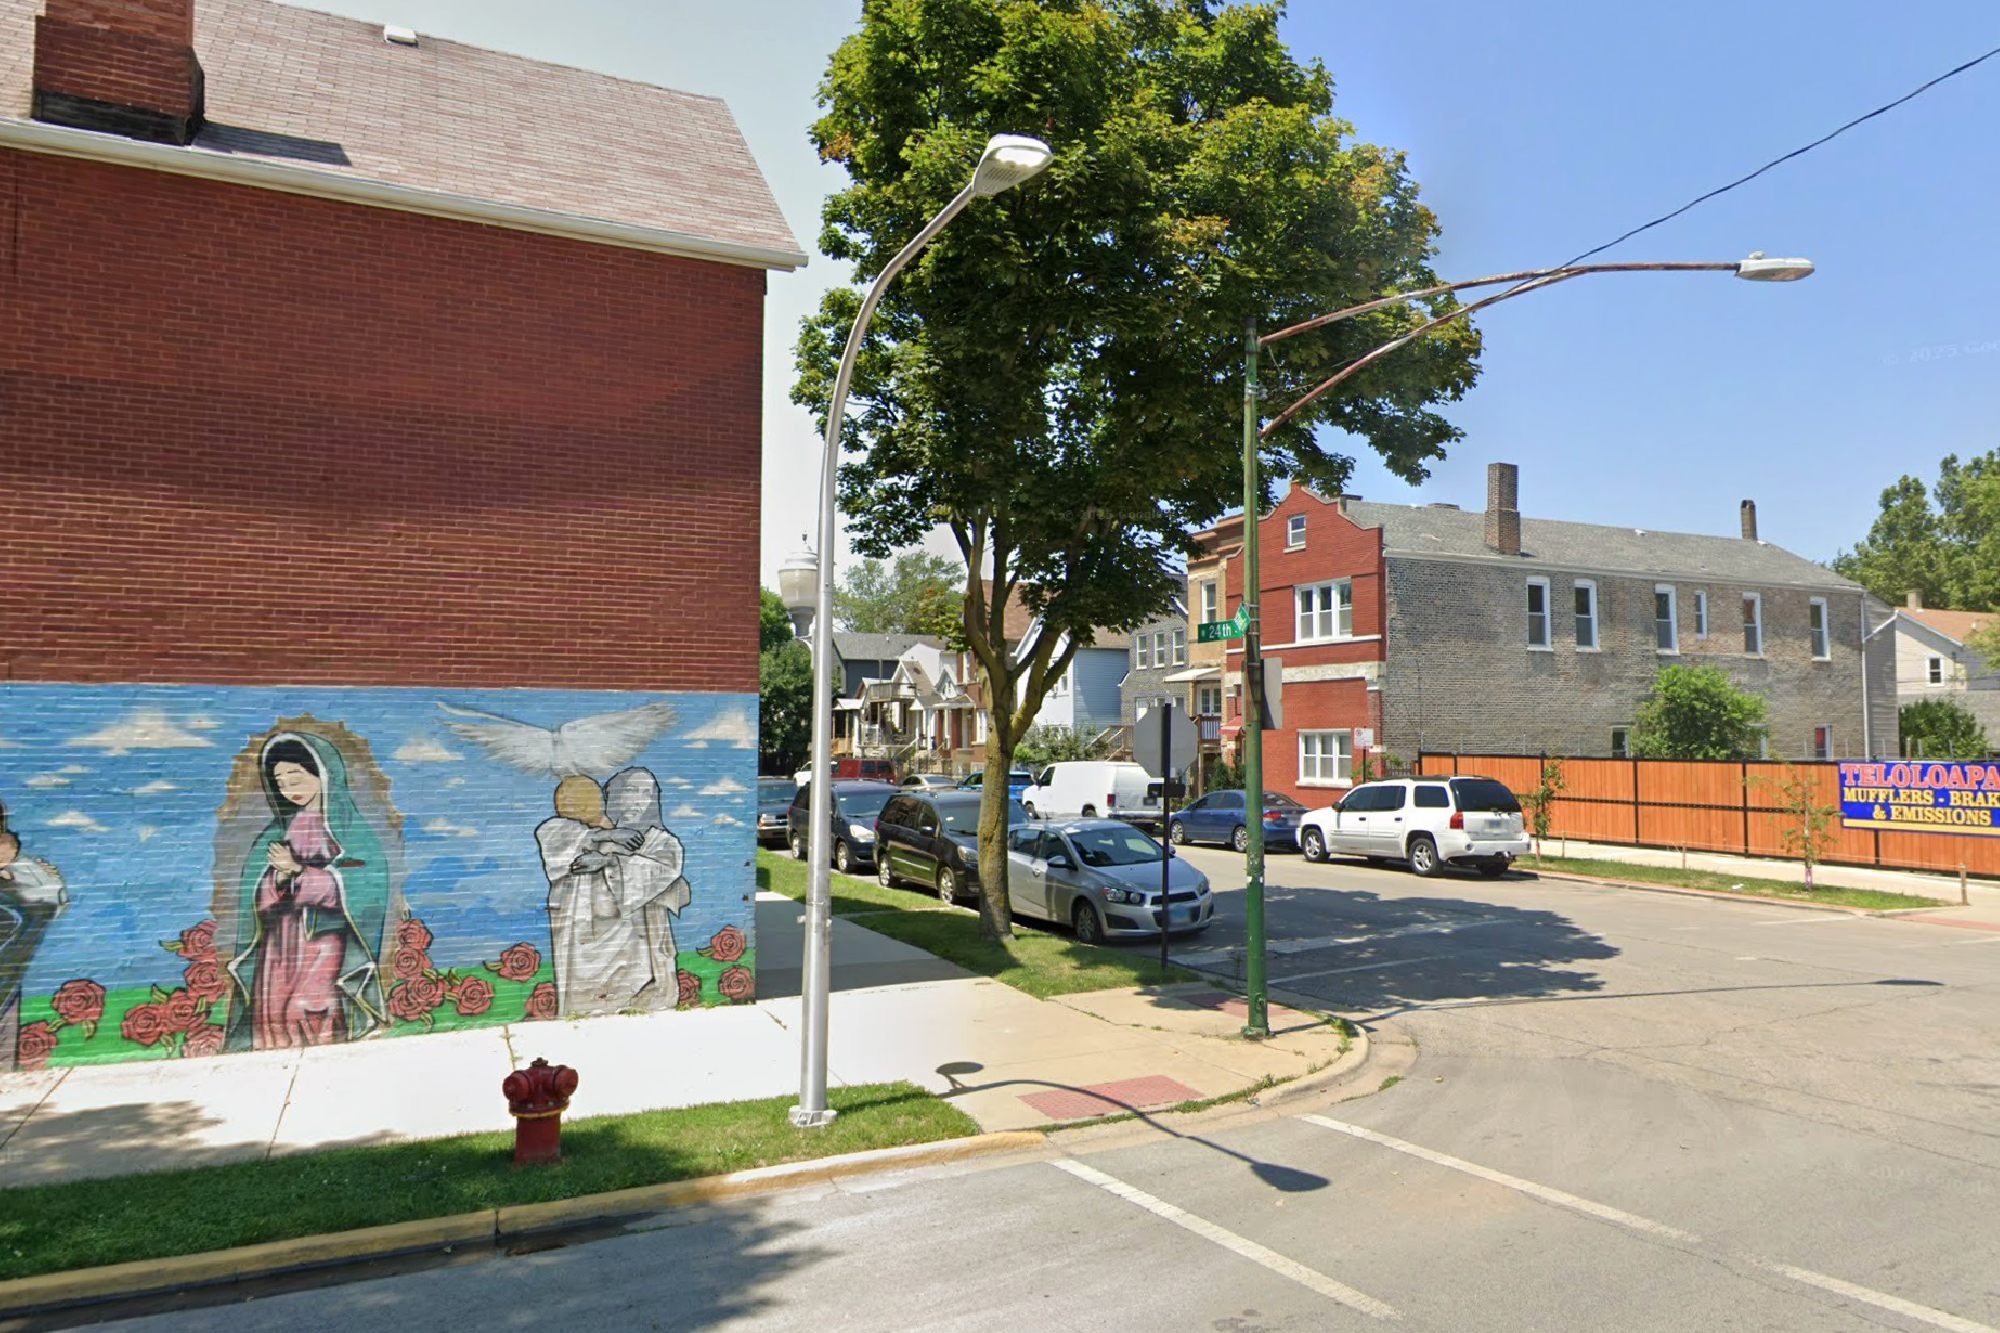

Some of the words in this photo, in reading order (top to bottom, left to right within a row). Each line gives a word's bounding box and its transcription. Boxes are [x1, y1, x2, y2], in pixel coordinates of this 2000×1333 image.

[1209, 623, 1231, 639] 24th
[1840, 763, 2000, 790] TELOLOAPA
[1843, 787, 1935, 806] MUFFLERS
[1949, 790, 2000, 807] BRAK
[1873, 804, 1887, 819] &
[1890, 805, 1992, 826] EMISSIONS
